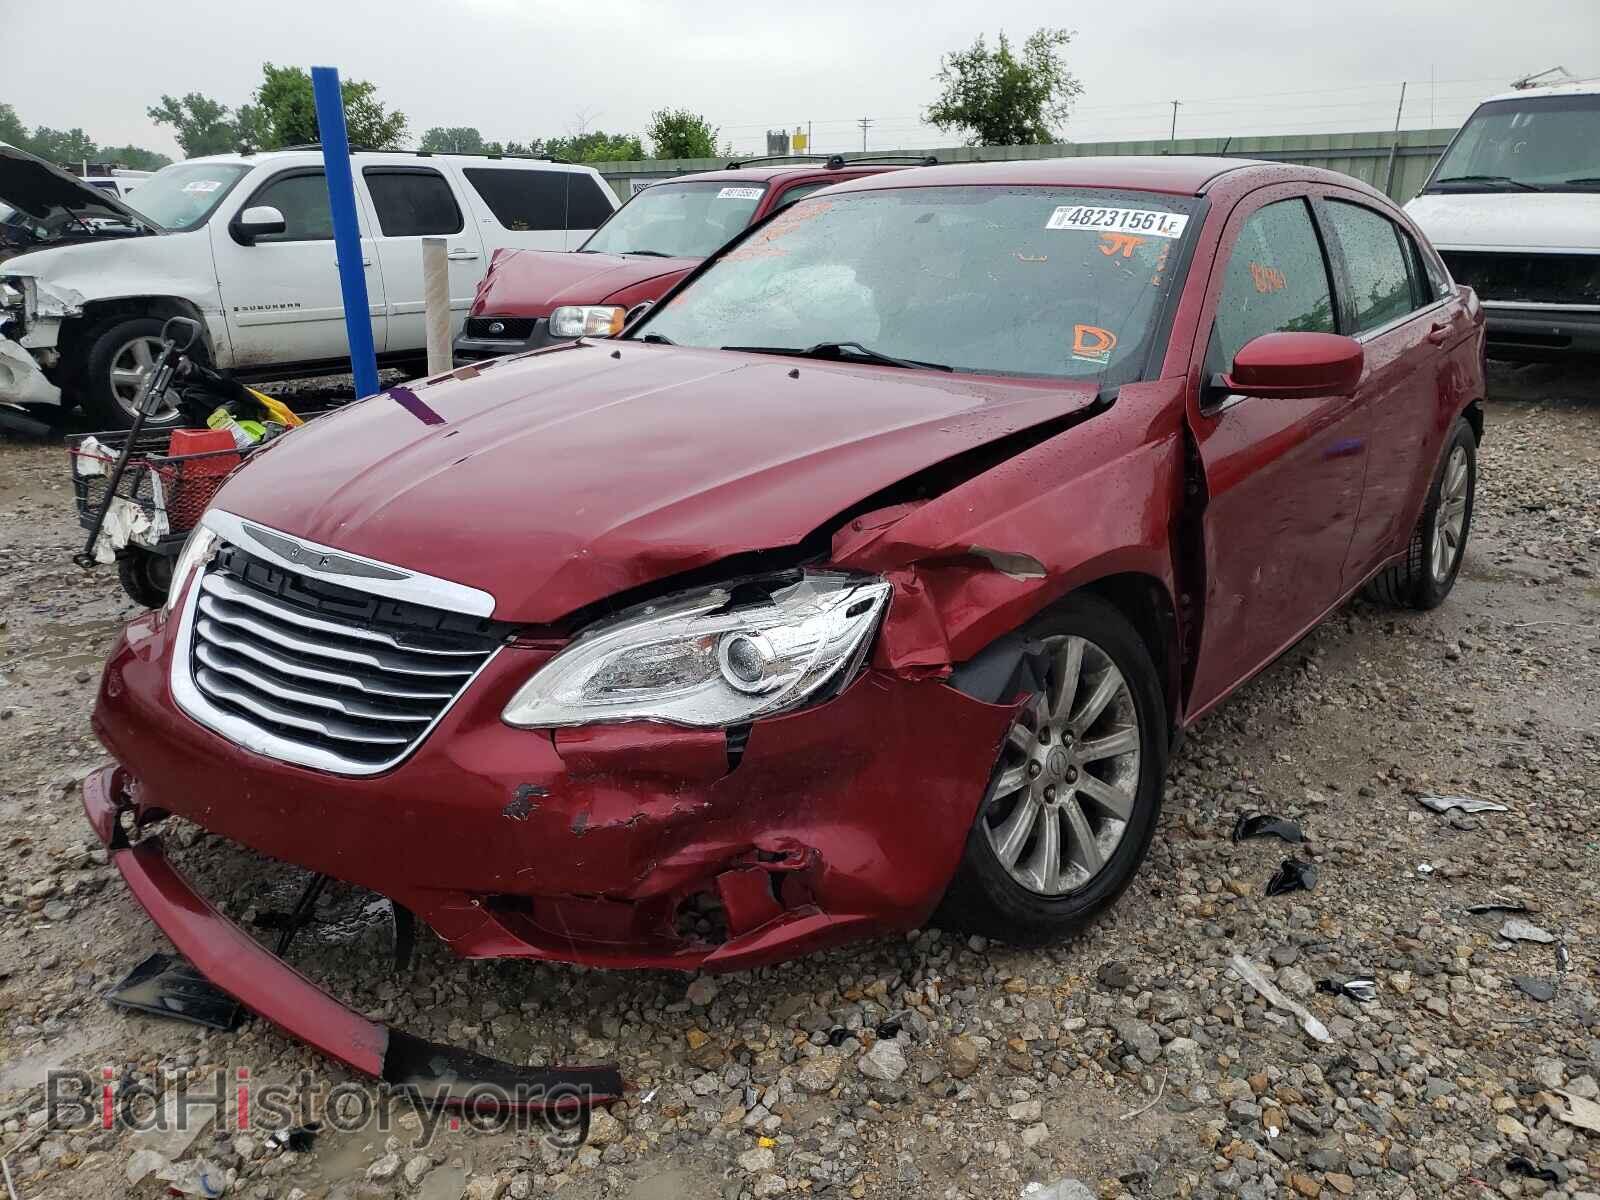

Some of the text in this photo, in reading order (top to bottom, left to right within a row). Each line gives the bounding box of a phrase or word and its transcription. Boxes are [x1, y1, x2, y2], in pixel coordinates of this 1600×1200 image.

[1067, 207, 1168, 231] 48231561
[239, 302, 301, 312] SUBURBAN
[1072, 324, 1117, 357] D
